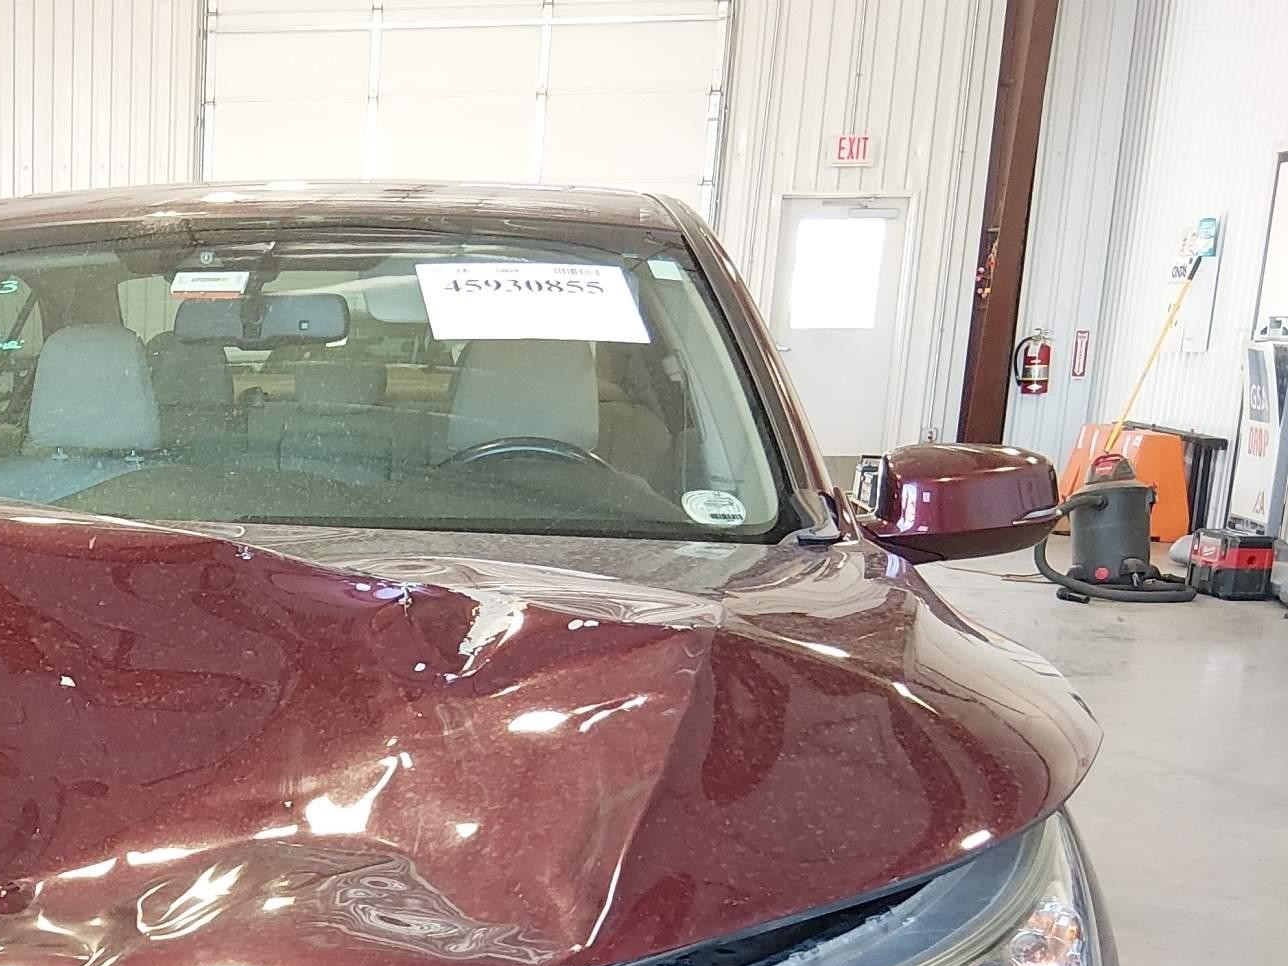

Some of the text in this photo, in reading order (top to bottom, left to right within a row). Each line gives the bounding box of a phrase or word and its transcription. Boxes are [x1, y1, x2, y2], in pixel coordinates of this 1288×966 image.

[837, 136, 870, 160] EXIT
[444, 278, 605, 295] 45930855
[1247, 425, 1270, 458] DROP
